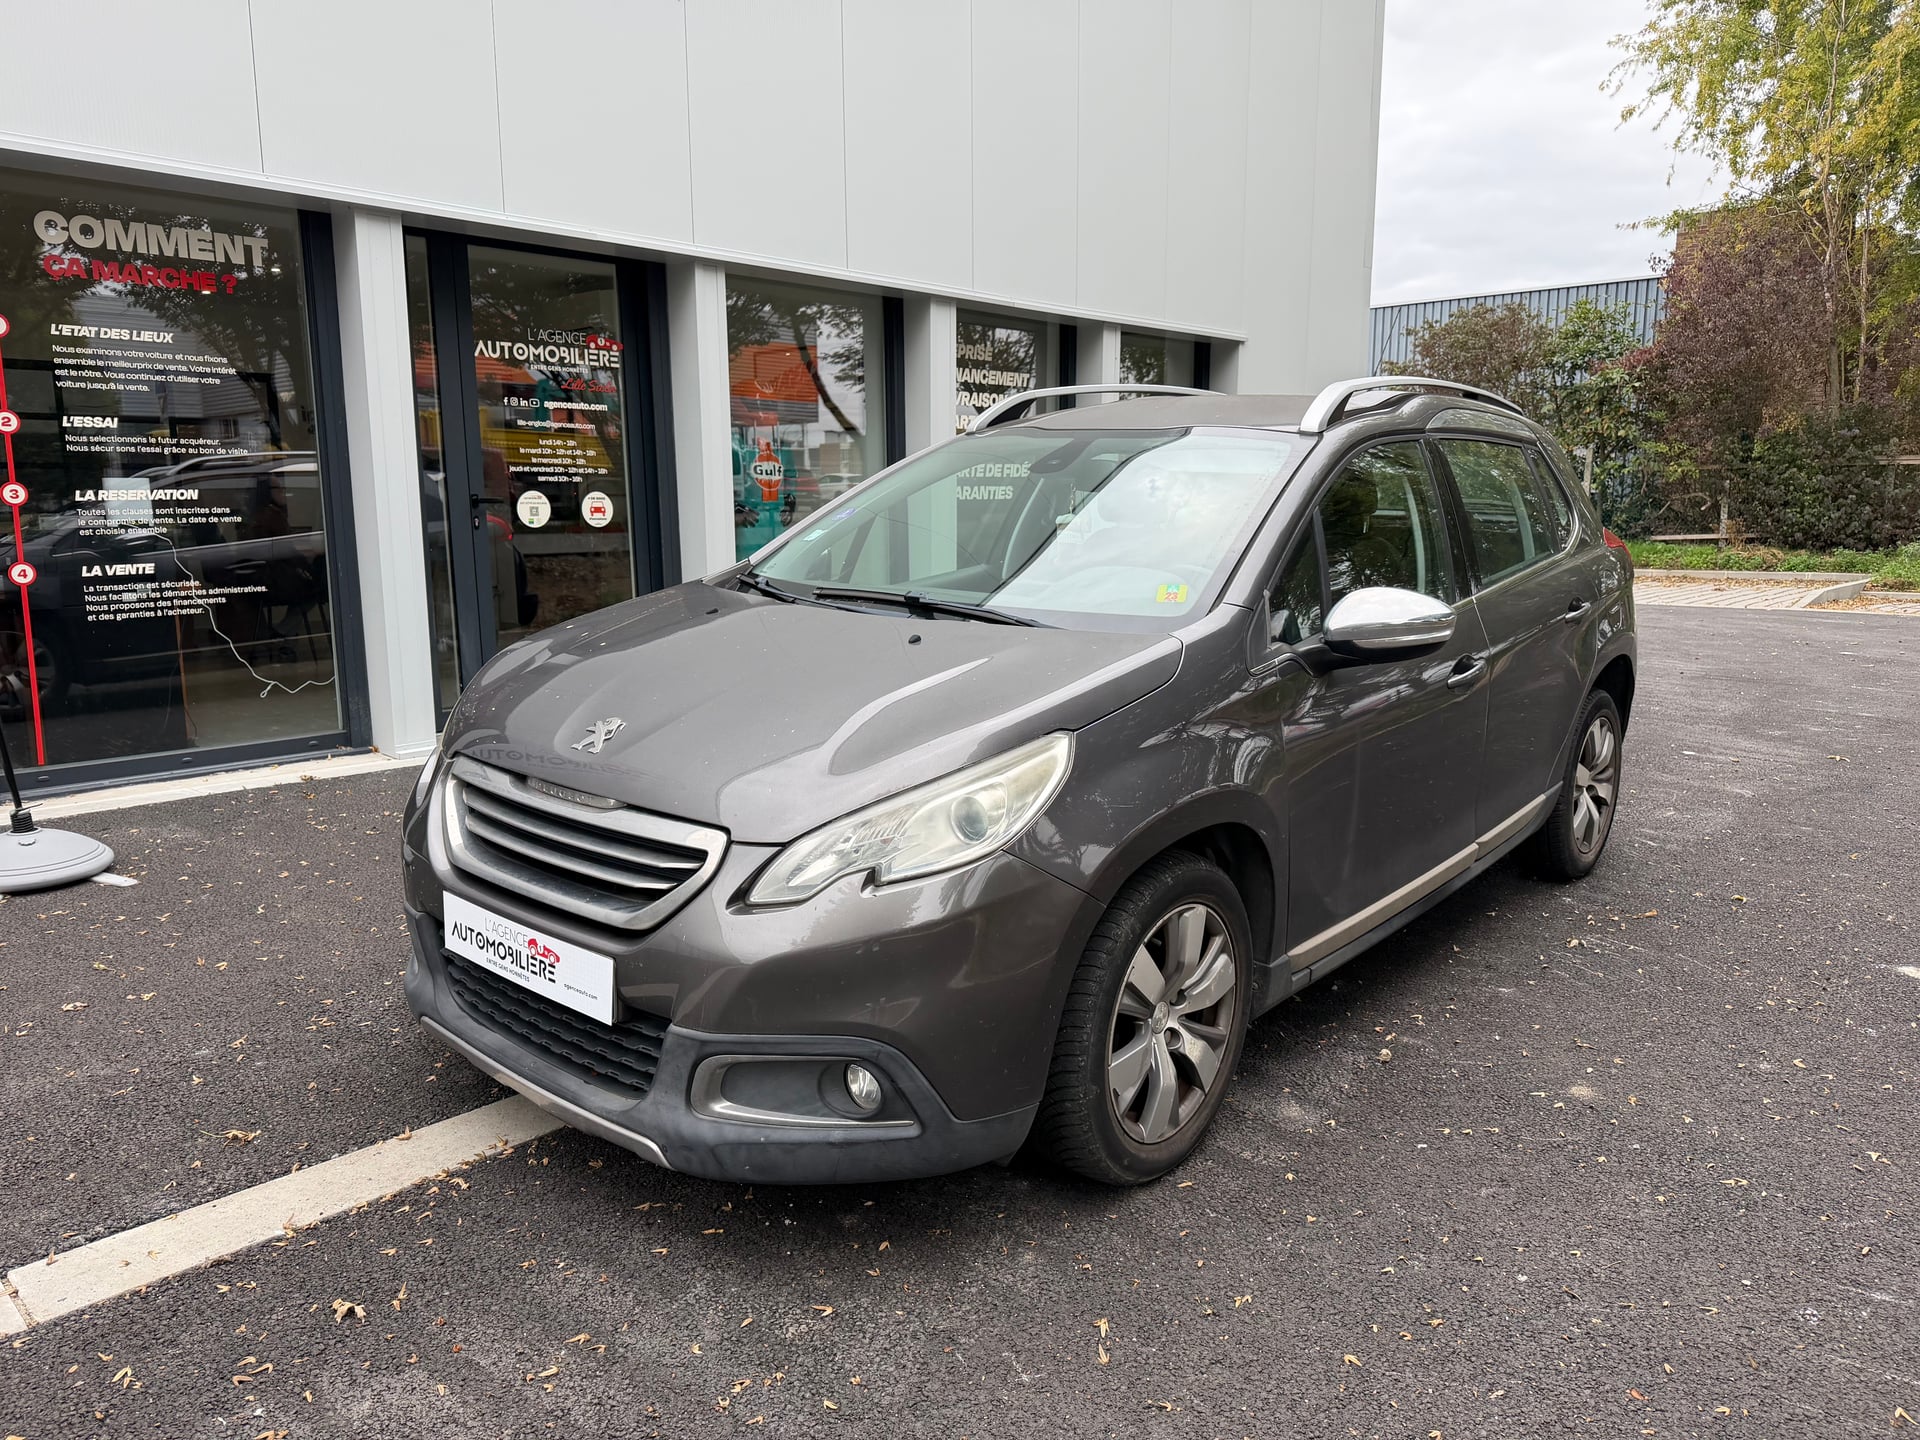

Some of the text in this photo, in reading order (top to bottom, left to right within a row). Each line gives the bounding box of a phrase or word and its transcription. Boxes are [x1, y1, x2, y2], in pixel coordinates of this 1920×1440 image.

[33, 210, 268, 267] COMMENT
[43, 254, 238, 295] ÇA MARCHE ?
[50, 323, 174, 344] L'ETAT DES LIEUX
[527, 328, 587, 346] L'AGENCE
[52, 344, 228, 364] Nous examinons votre voiture et nous fixons
[53, 357, 96, 367] ensemble
[96, 359, 105, 367] le
[153, 362, 164, 370] de
[164, 364, 189, 372] vente.
[189, 365, 211, 374] Votre
[211, 366, 238, 375] intérêt
[69, 369, 78, 377] le
[78, 369, 104, 378] nôtre.
[103, 370, 125, 379] Vous
[125, 371, 167, 381] continuez
[167, 374, 200, 384] d'utiliser
[200, 377, 221, 385] votre
[55, 380, 87, 389] voiture
[116, 382, 124, 391] la
[124, 383, 150, 392] vente.
[543, 400, 608, 412] agenceauto.com
[1, 417, 12, 427] 2
[62, 415, 118, 429] L'ESSAI
[64, 434, 87, 442] Nous
[148, 436, 157, 444] le
[158, 436, 178, 444] futur
[539, 438, 553, 446] lundi
[66, 444, 89, 452] Nous
[137, 445, 162, 453] l'essai
[163, 446, 187, 455] grâce
[199, 446, 215, 454] bon
[216, 447, 226, 455] de
[537, 457, 563, 465] mercredi
[509, 465, 523, 473] jeudi
[753, 464, 783, 477] Gulf
[985, 463, 1003, 478] DE
[9, 489, 20, 499] 3
[75, 489, 199, 502] LA RESERVATION
[76, 506, 231, 516] Toutes les clauses sont inscrites dans
[77, 515, 242, 527] le compromis de vente. La date de vente
[79, 526, 168, 536] est choisie ensemble
[17, 569, 28, 579] 4
[81, 562, 155, 577] LA VENTE
[83, 585, 95, 593] La
[96, 582, 146, 592] transaction
[146, 582, 160, 590] est
[84, 585, 268, 602] Nous facilitons les démarches administratives.
[85, 597, 226, 612] Nous proposons des financements
[87, 607, 205, 622] et des garanties à l'acheteur.
[484, 916, 529, 949] L'AGENCE
[563, 983, 598, 1000] agenceauto.com
